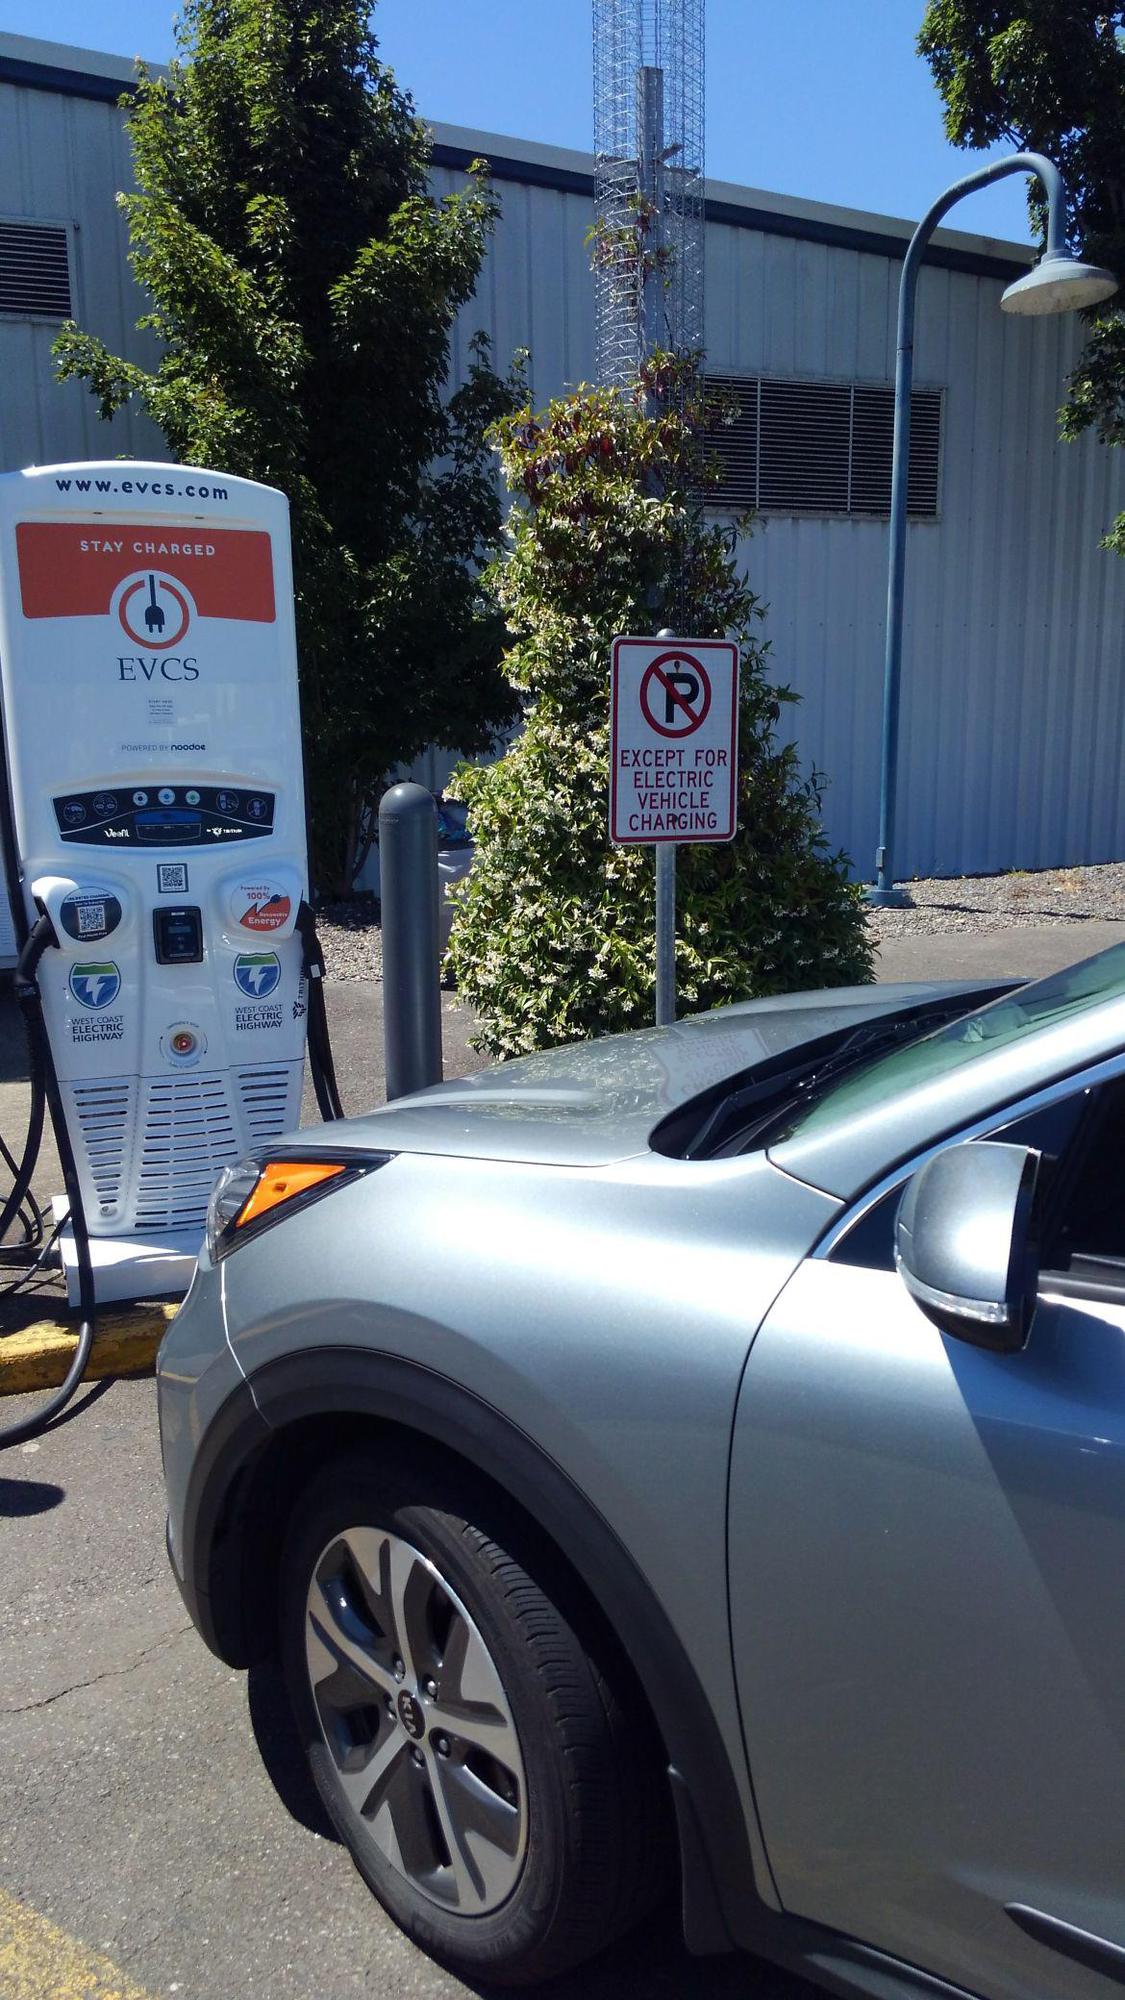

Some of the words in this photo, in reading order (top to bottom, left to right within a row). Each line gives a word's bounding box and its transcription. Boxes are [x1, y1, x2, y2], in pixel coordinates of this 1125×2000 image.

[55, 479, 229, 500] www.evcs.com
[80, 540, 123, 553] STAY
[133, 541, 216, 556] CHARGED
[117, 657, 200, 681] EVCS
[121, 744, 158, 752] POWERED
[159, 744, 169, 752] BY
[170, 743, 206, 752] noodoe
[620, 750, 685, 767] EXCEPT
[695, 750, 728, 767] FOR
[634, 770, 714, 788] ELECTRIC
[637, 791, 710, 809] VEHICLE
[628, 812, 718, 831] CHARGING
[247, 892, 271, 900] 100%
[248, 916, 281, 926] Energy
[235, 1006, 256, 1014] WEST
[258, 1004, 282, 1013] COAST
[71, 1017, 95, 1025] WEST
[97, 1015, 124, 1024] COAST
[236, 1012, 283, 1022] ELECTRIC
[72, 1023, 124, 1034] ELECTRIC
[236, 1020, 283, 1031] HIGHWAY
[72, 1032, 124, 1042] HIGHWAY
